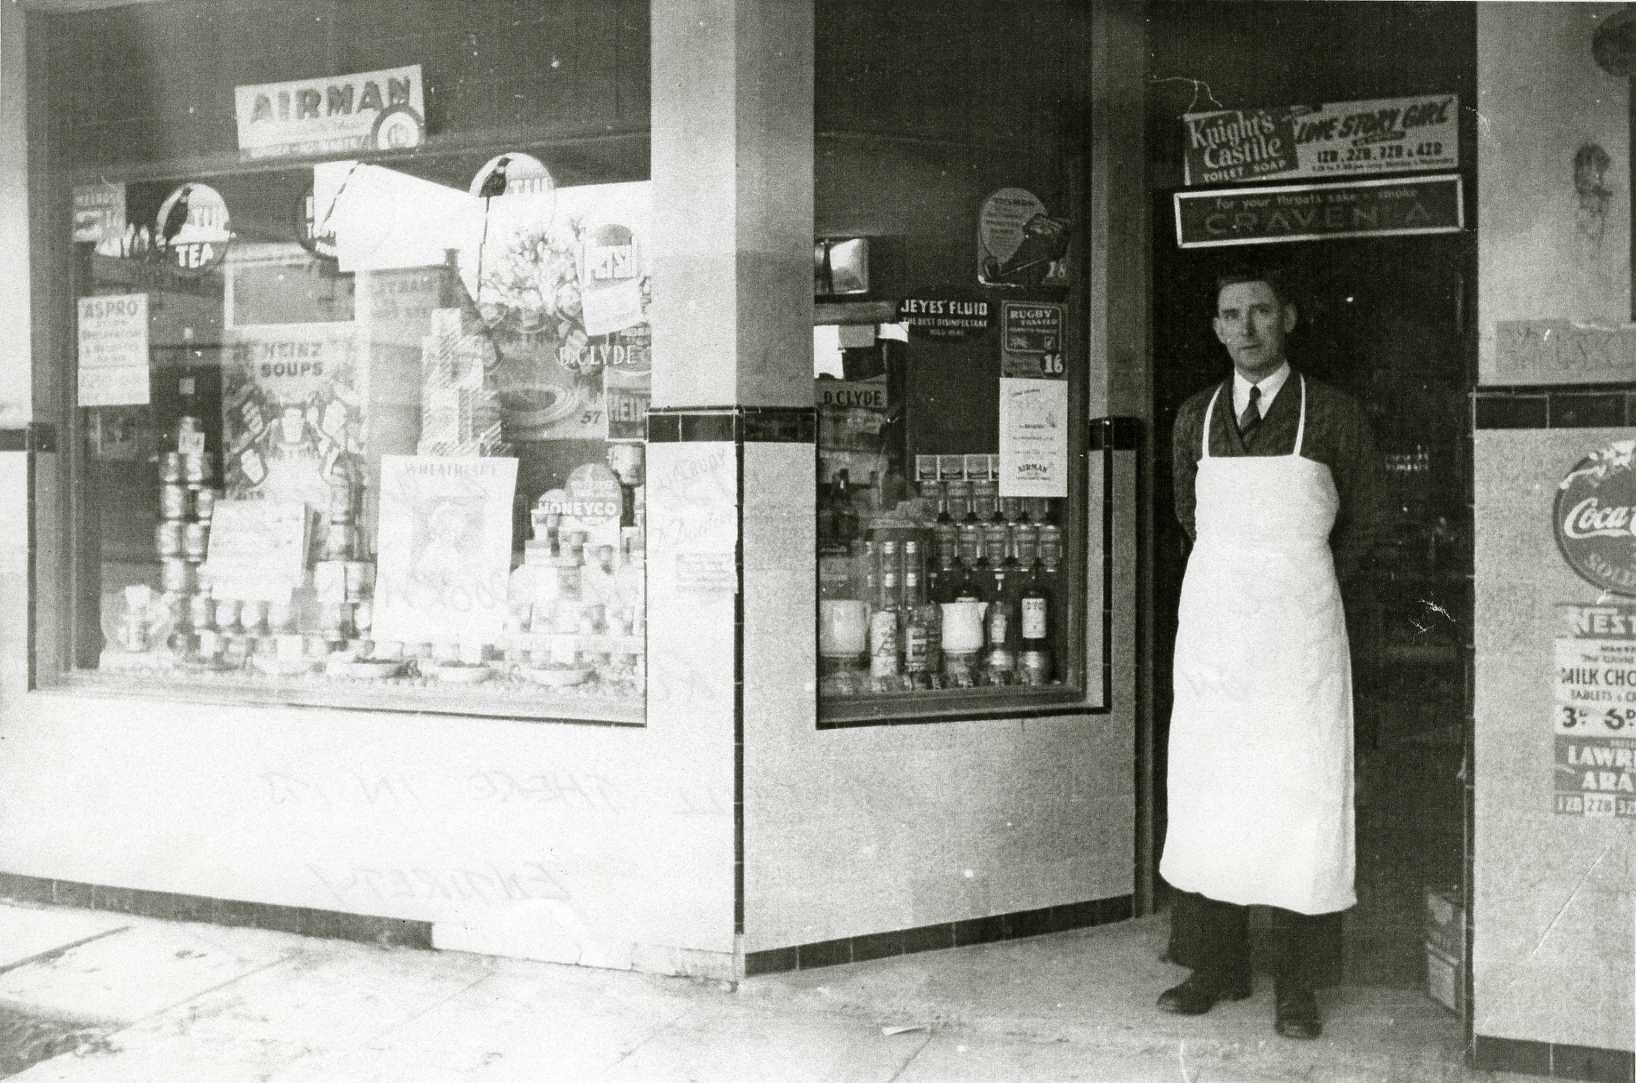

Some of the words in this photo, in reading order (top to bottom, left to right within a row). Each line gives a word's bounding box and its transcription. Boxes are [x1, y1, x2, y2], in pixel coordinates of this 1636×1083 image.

[251, 76, 411, 123] AIRMAN
[1402, 98, 1453, 129] GIRL
[1186, 111, 1275, 149] Knight's
[1204, 134, 1282, 169] Castile
[1202, 166, 1244, 183] TOILET
[1253, 159, 1286, 173] SOAP
[1206, 207, 1379, 235] CRAVEN
[176, 243, 214, 269] TEA
[83, 300, 138, 319] ASPRO
[949, 300, 987, 316] FLUID
[1010, 309, 1052, 319] RUGBY
[260, 361, 323, 378] SOUPS
[1043, 353, 1064, 374] 16
[836, 390, 882, 407] CLYDE
[1561, 667, 1599, 685] MILK
[1570, 689, 1612, 701] TABLETS
